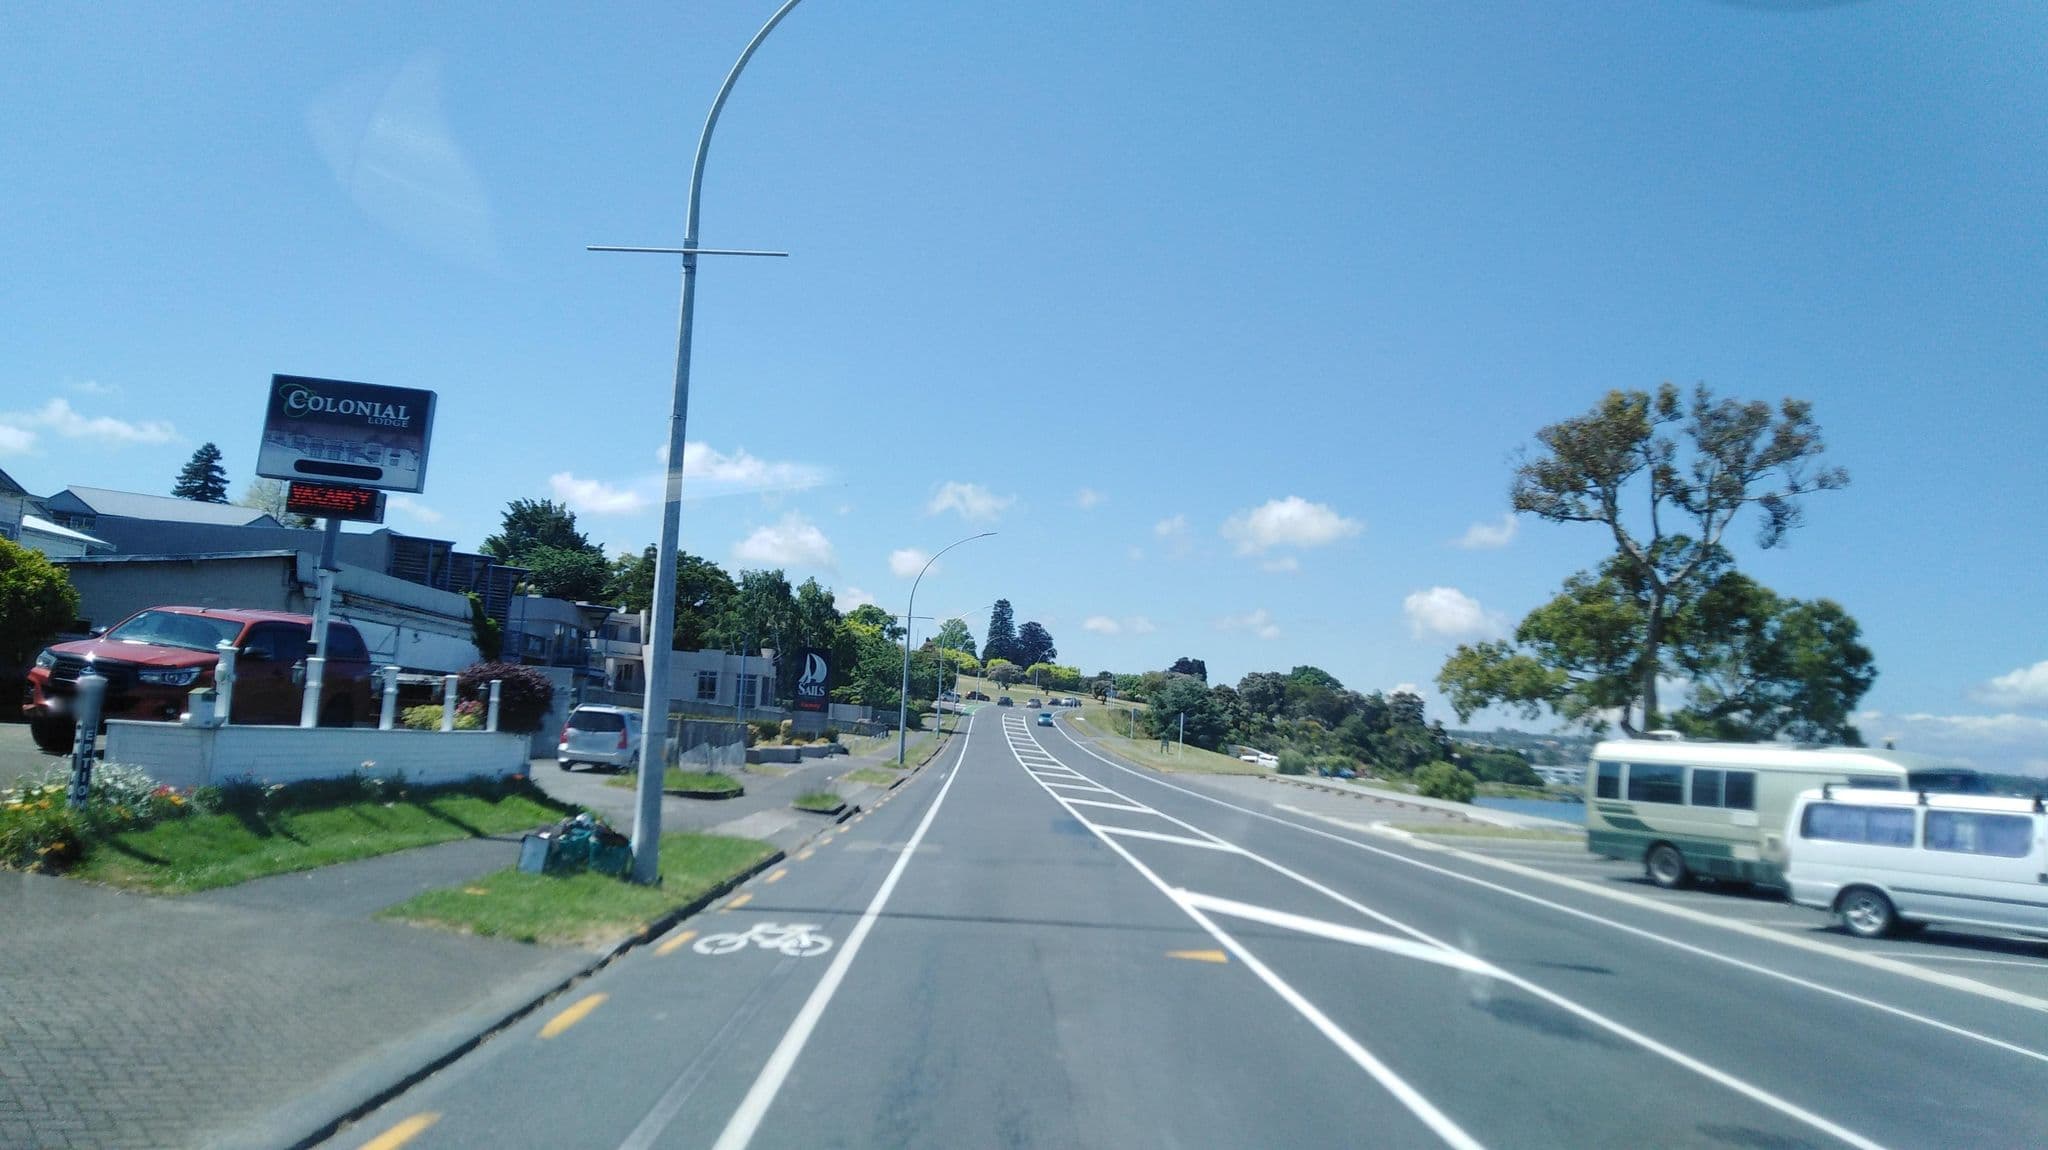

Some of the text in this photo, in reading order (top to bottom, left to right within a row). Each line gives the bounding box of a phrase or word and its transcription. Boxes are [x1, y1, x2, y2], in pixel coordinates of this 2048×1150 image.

[288, 390, 410, 420] COLONIAL
[368, 417, 409, 428] LODGE
[798, 682, 825, 696] SAILS
